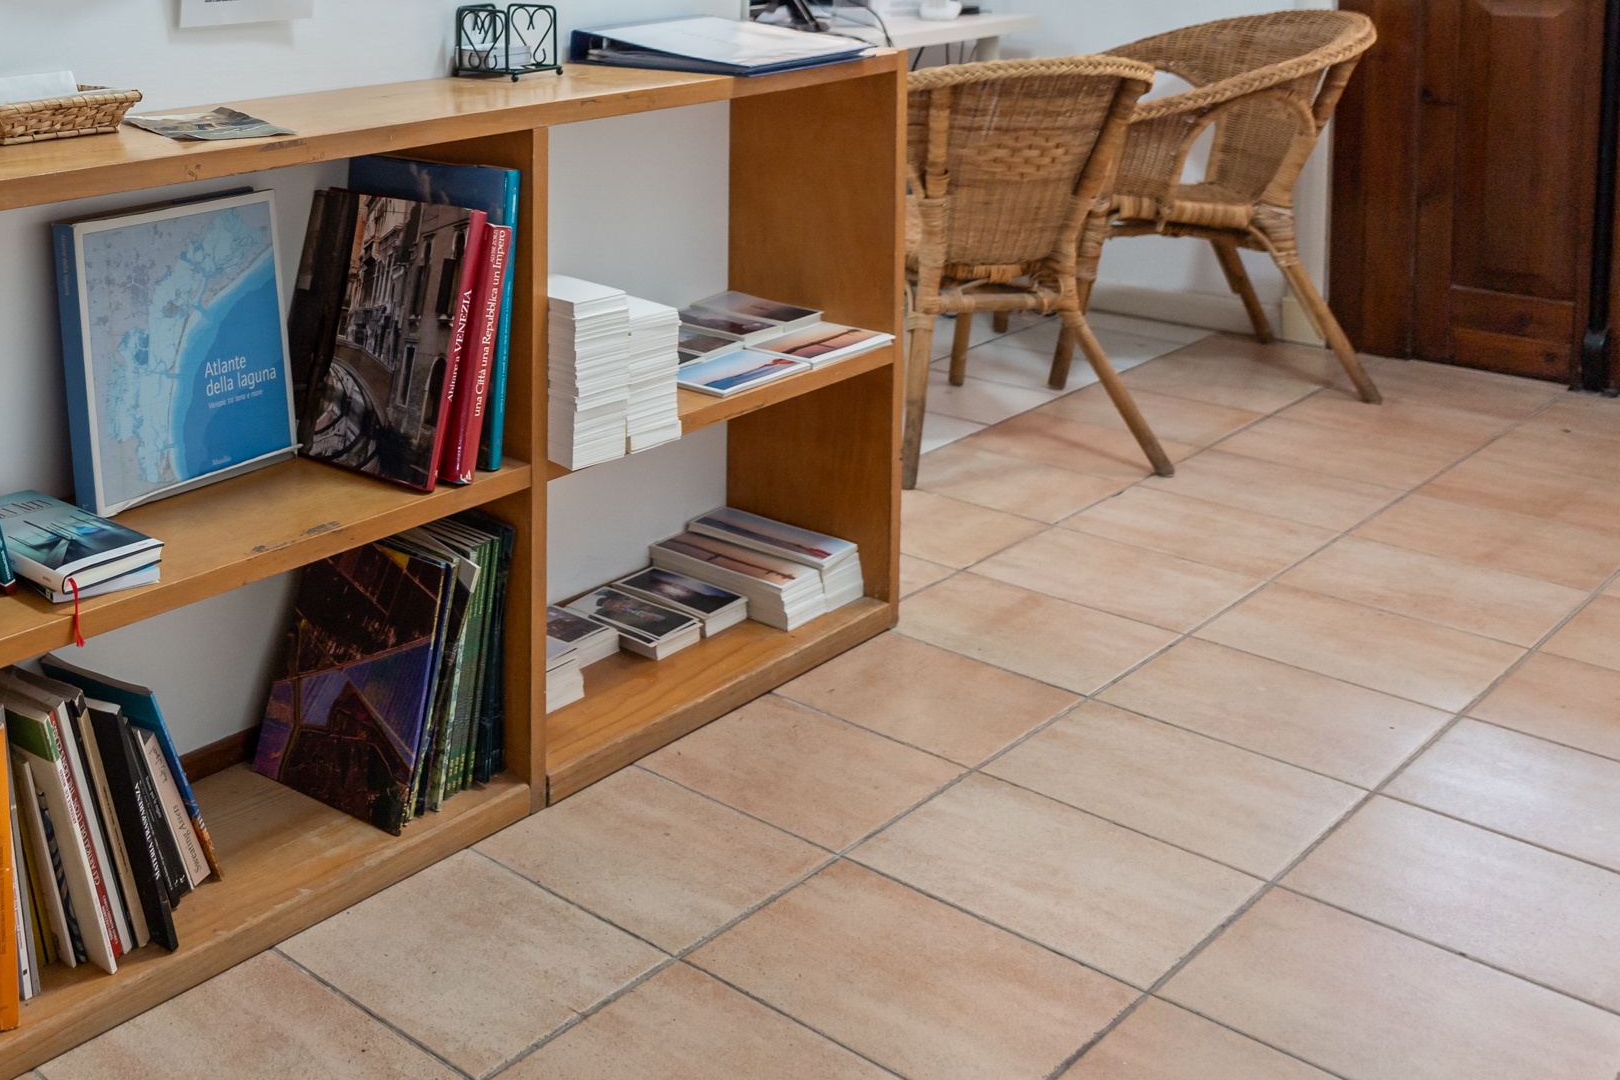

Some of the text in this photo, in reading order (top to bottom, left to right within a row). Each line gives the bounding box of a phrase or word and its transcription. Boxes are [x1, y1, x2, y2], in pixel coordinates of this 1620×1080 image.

[493, 230, 506, 268] Impero
[493, 270, 499, 284] un
[482, 287, 497, 344] Repubblica
[447, 364, 458, 402] Abitare
[453, 289, 472, 352] VENEZIA
[204, 354, 247, 378] Atlante
[206, 365, 277, 396] della laguna
[476, 368, 487, 395] Città
[474, 397, 482, 417] una
[171, 805, 202, 873] Sweating Assets
